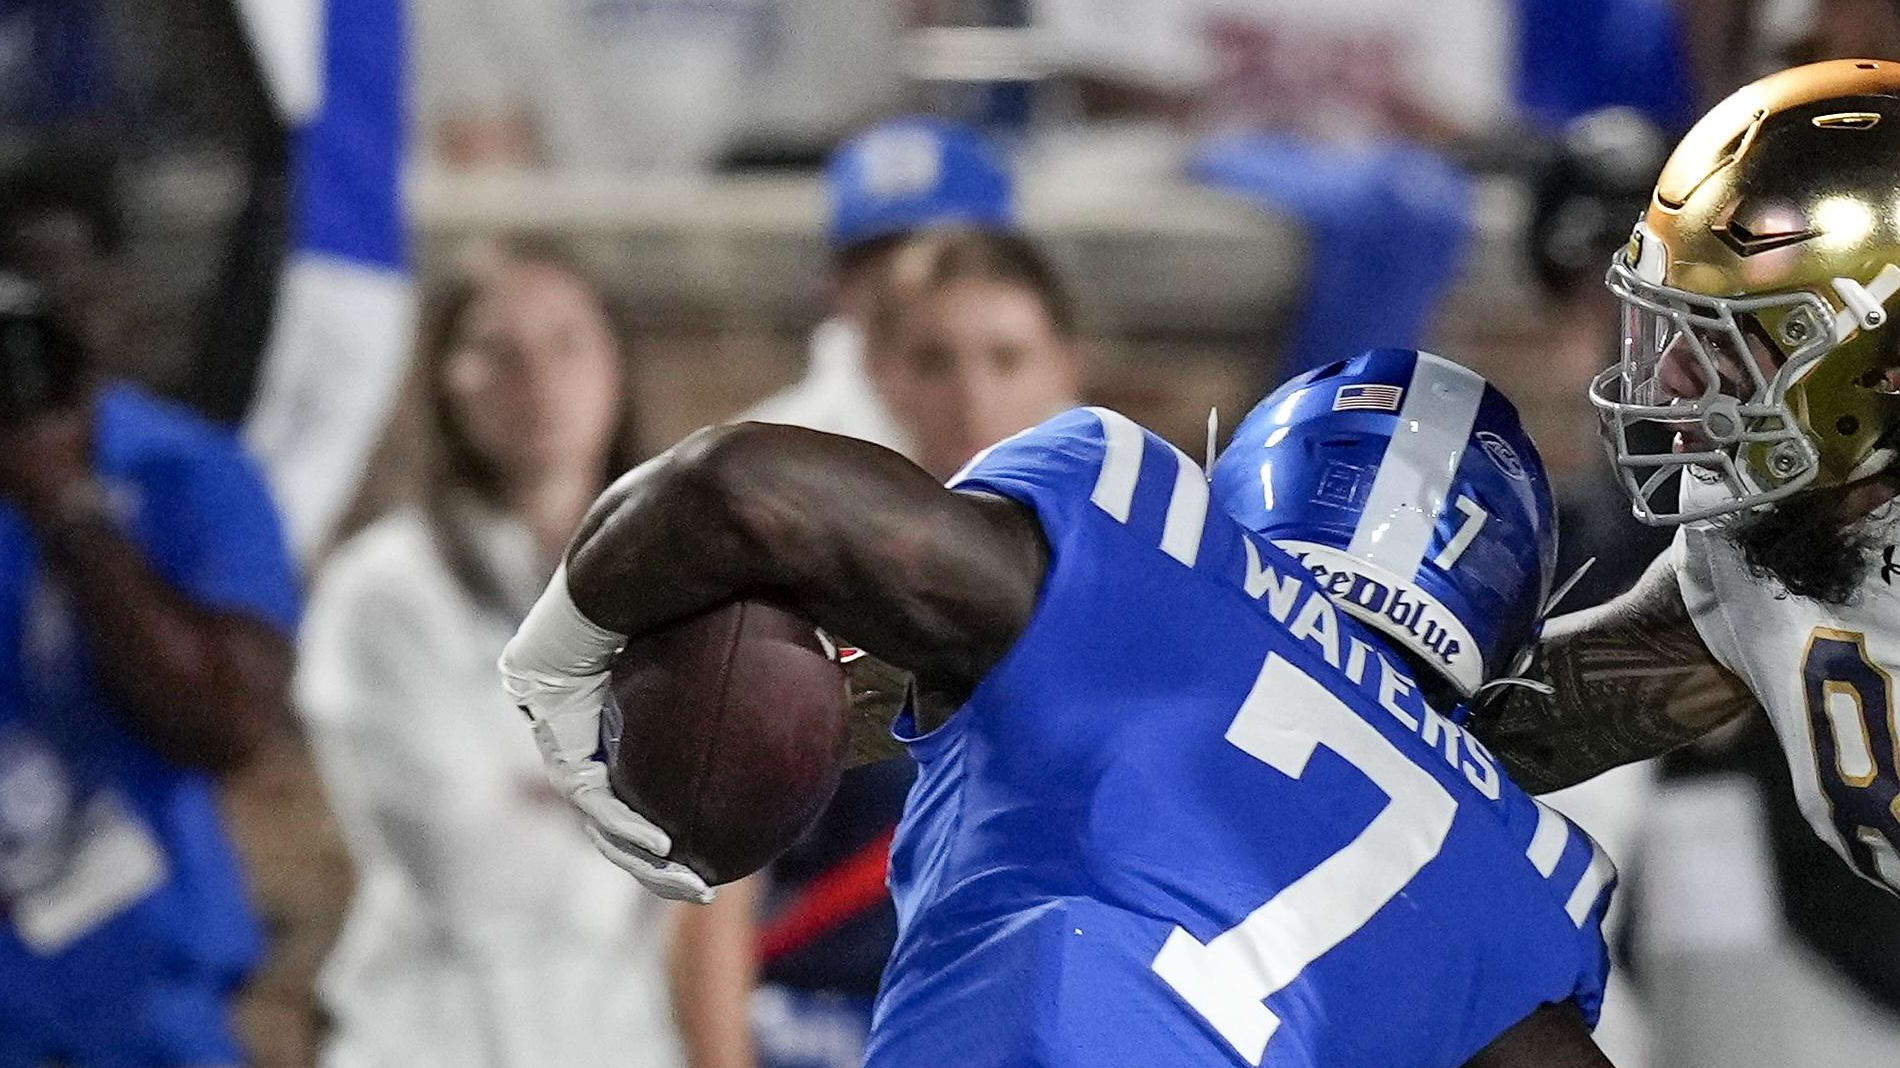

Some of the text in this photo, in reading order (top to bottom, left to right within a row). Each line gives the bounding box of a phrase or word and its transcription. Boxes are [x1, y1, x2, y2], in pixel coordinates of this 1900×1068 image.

[1436, 494, 1488, 571] 7
[1243, 534, 1501, 801] WATERS
[1151, 650, 1459, 1067] 7
